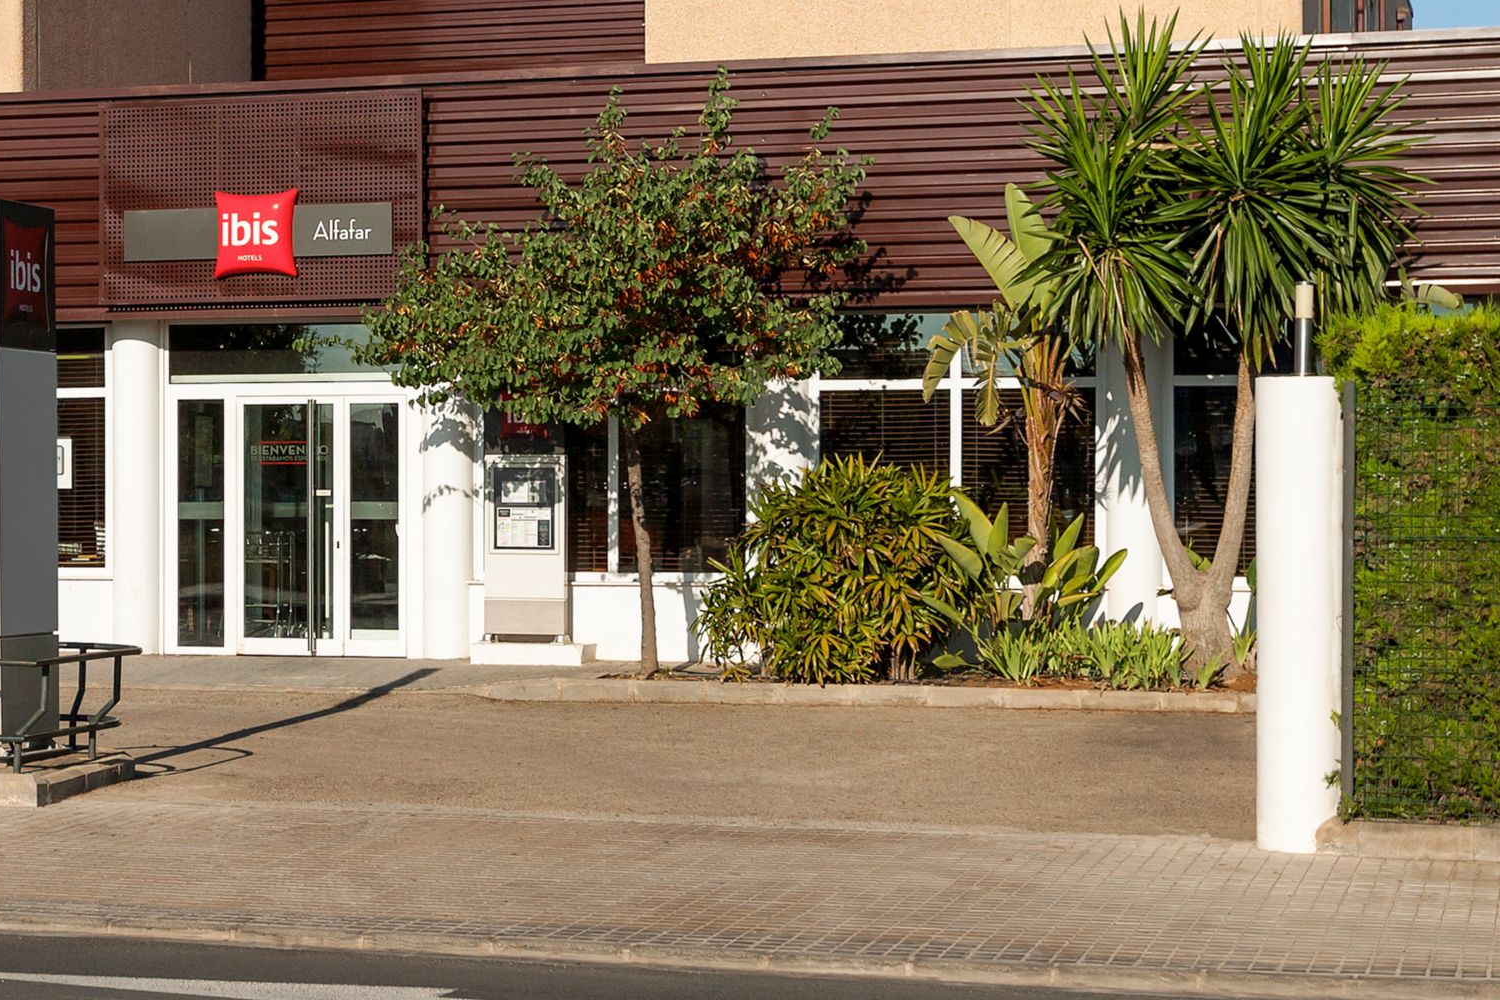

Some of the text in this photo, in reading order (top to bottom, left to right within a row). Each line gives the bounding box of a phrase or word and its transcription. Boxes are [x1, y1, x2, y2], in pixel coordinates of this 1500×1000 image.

[221, 212, 372, 247] ibis Alfafar
[237, 254, 263, 262] HOTELS
[10, 249, 41, 293] ibis
[250, 445, 329, 455] BIENVENIO
